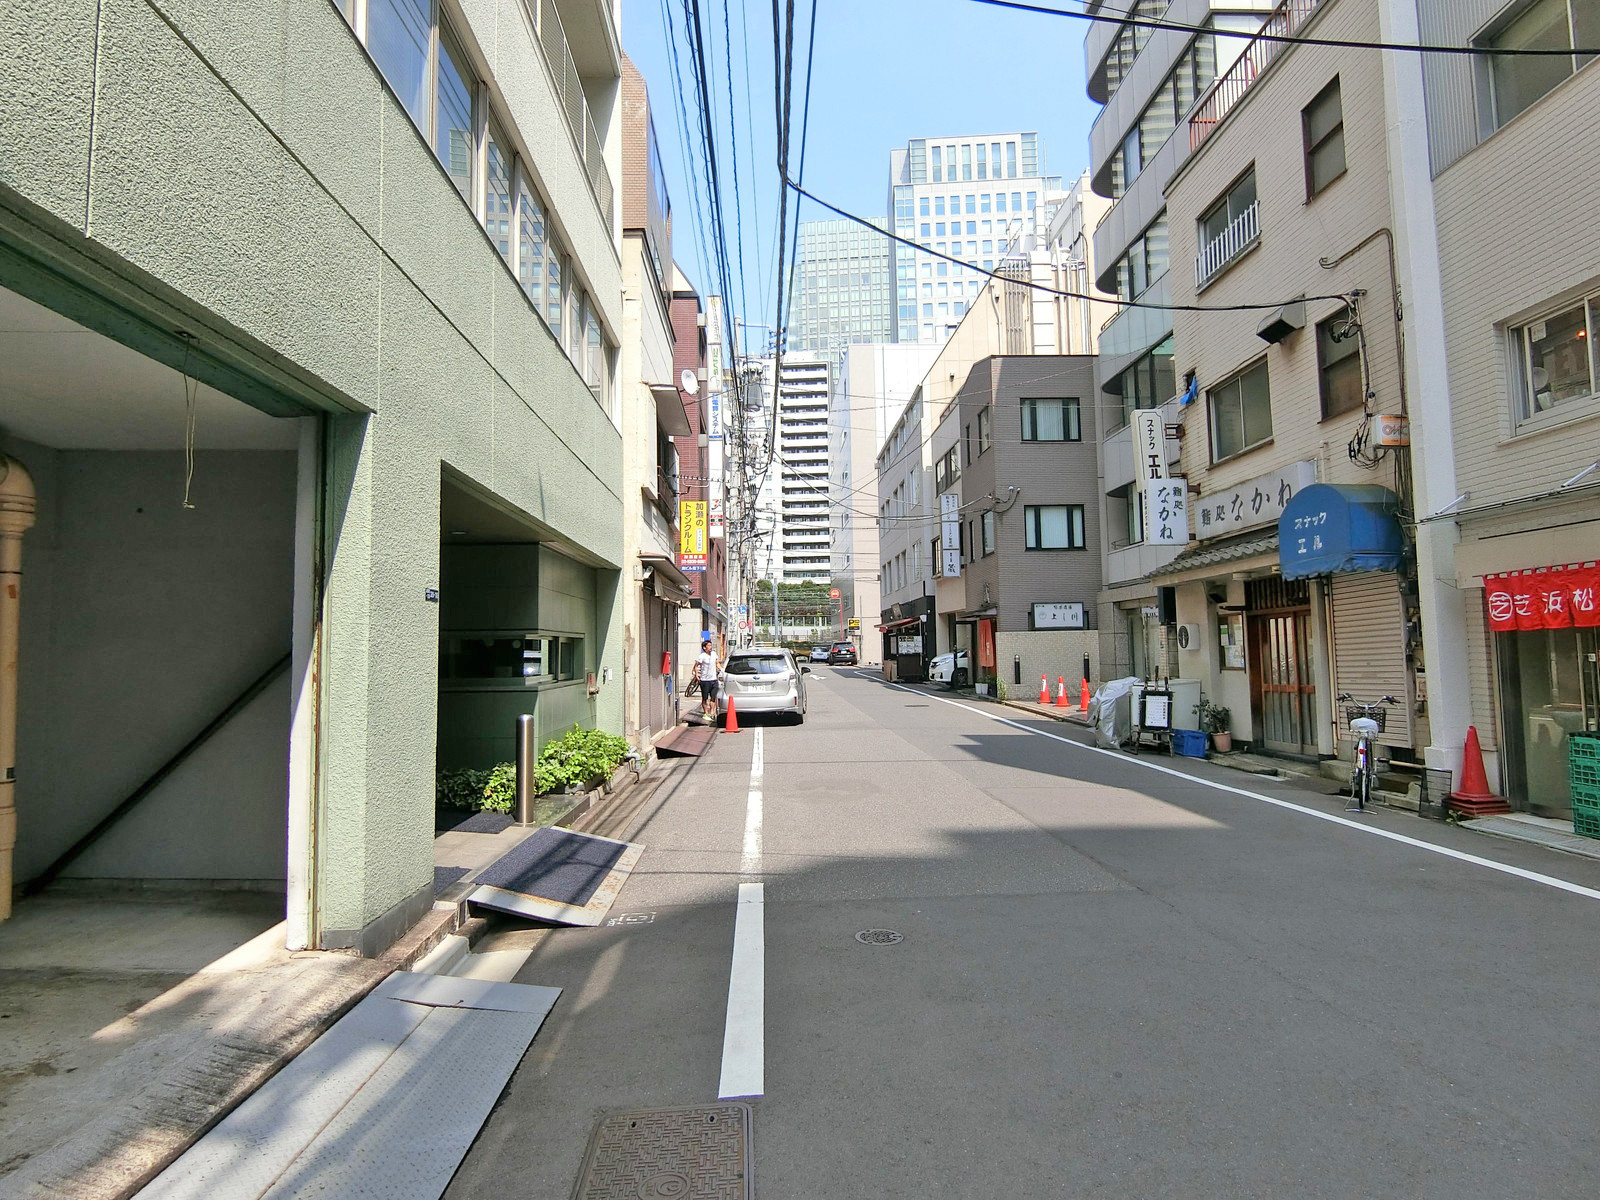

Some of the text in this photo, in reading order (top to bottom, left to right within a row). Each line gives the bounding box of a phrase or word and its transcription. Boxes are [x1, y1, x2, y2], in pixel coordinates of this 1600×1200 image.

[1146, 419, 1162, 479] スナック エル
[684, 502, 692, 553] トランクルーム
[1158, 486, 1177, 540] なかね
[1294, 511, 1327, 530] スナック
[1297, 535, 1323, 554] エル
